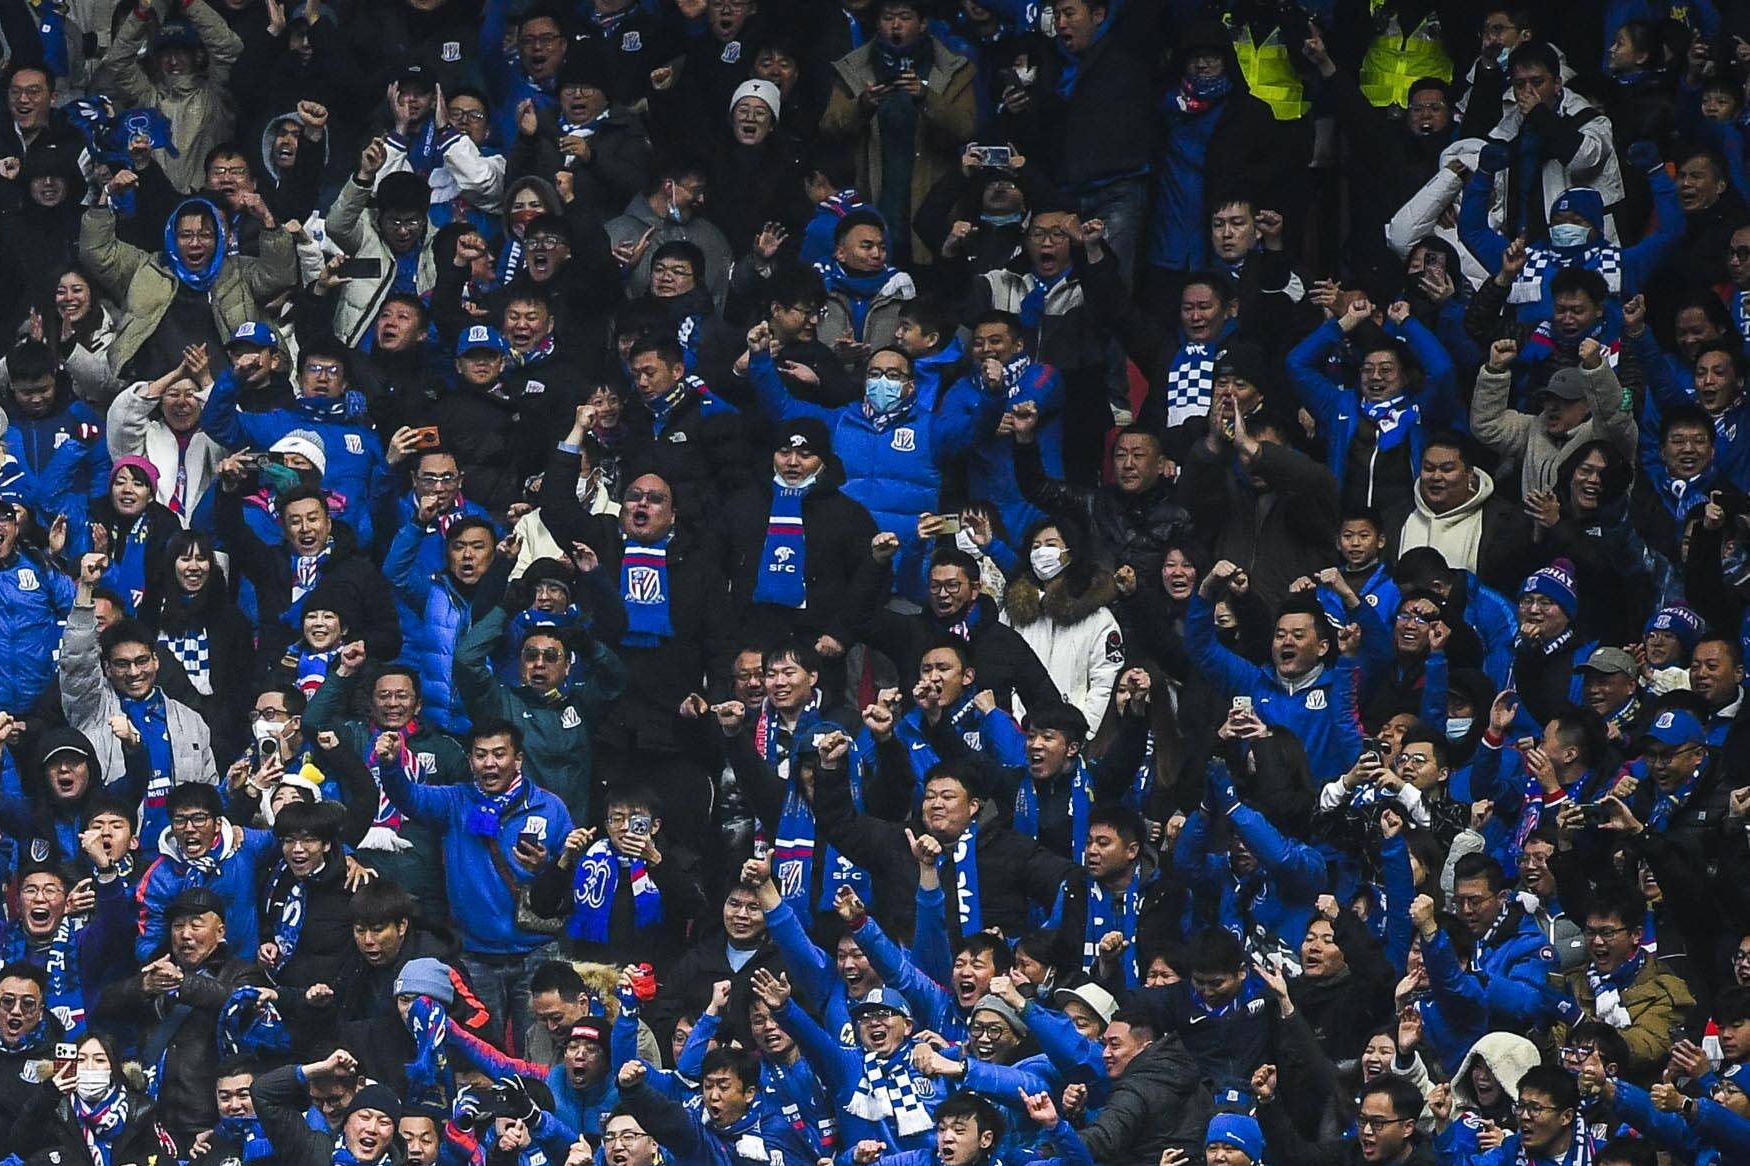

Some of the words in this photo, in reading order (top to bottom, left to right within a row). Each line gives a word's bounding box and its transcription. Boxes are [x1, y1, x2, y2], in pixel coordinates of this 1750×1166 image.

[769, 563, 796, 573] SFC
[832, 871, 862, 881] SFC
[575, 859, 612, 908] 30
